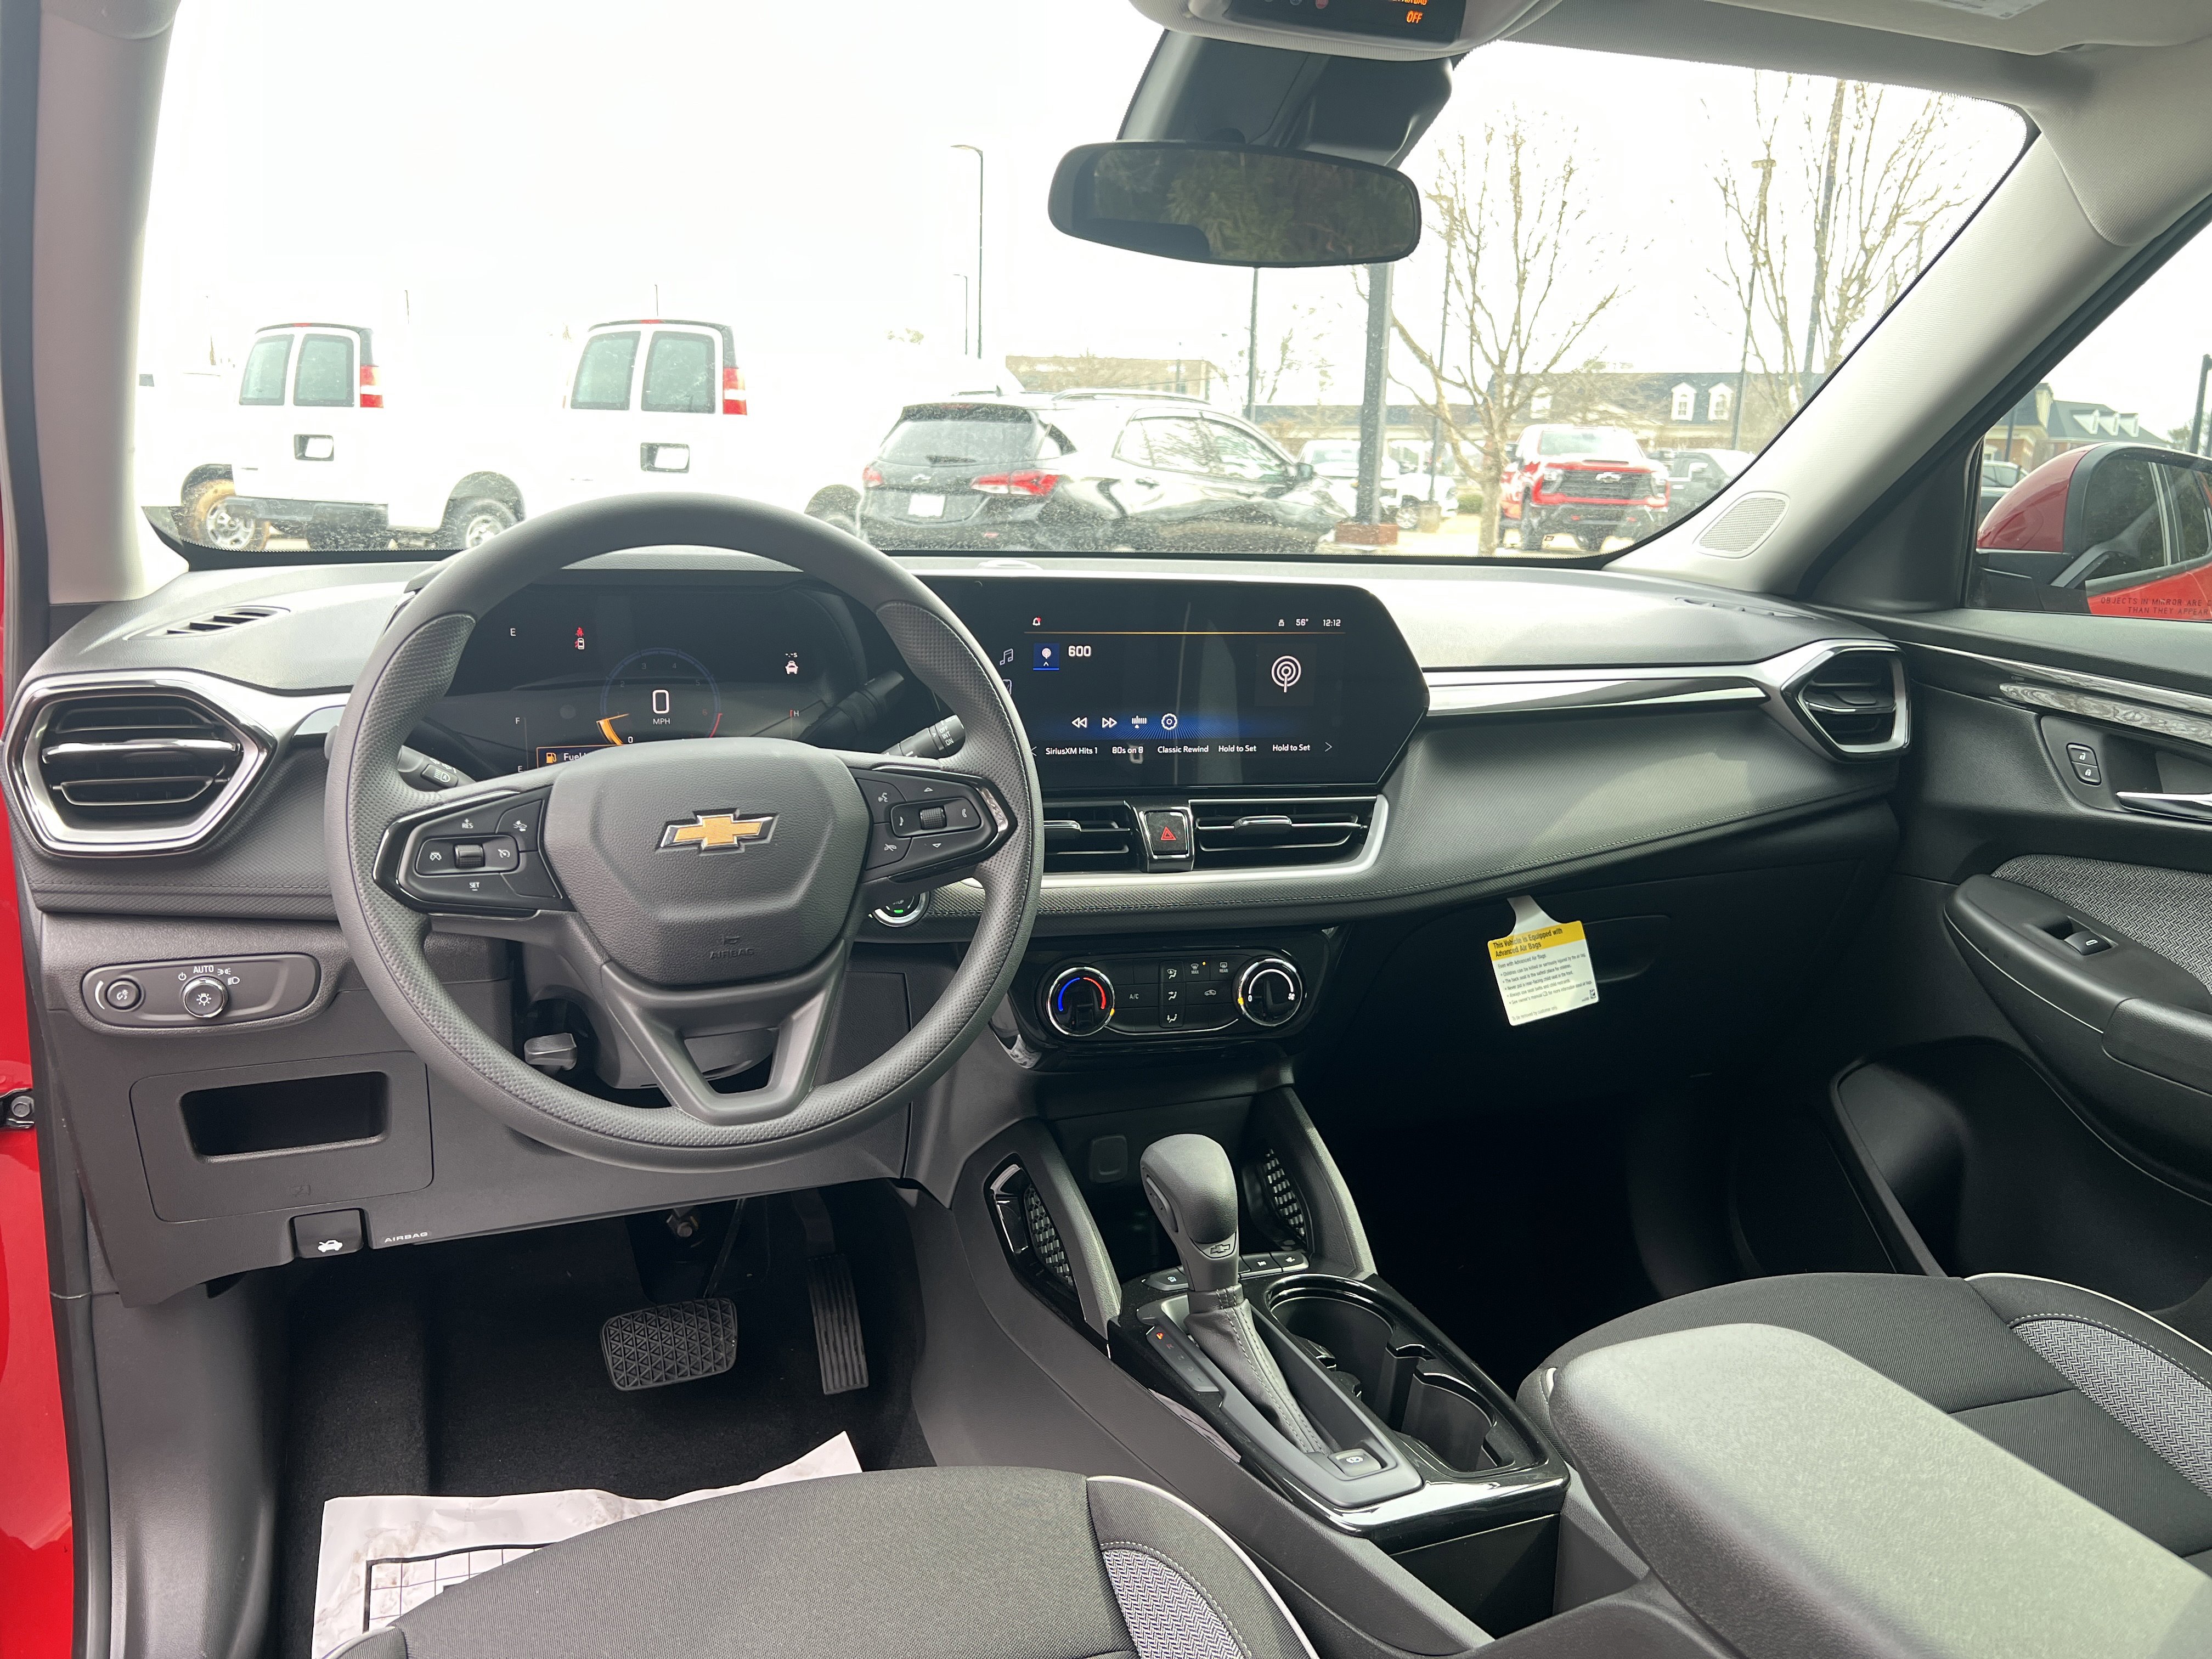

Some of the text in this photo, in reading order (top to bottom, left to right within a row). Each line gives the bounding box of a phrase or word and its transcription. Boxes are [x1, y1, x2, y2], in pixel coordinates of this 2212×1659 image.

[1406, 10, 1423, 23] OFF
[1322, 618, 1341, 627] 12:12
[510, 628, 516, 636] E
[1068, 645, 1092, 657] 600
[652, 689, 670, 714] 0
[942, 731, 951, 739] INT
[945, 737, 954, 746] ON
[1045, 747, 1077, 755] SiriusXM
[1111, 746, 1126, 754] 80s
[1183, 745, 1209, 753] Rewind
[563, 752, 582, 761] Fuel
[1503, 938, 1521, 946] Vehicle
[1528, 929, 1551, 941] Equipped
[710, 947, 755, 959] AIRBAG
[1496, 947, 1519, 957] Advanced
[193, 964, 214, 974] AUTO
[385, 1232, 428, 1243] AIRBAG
